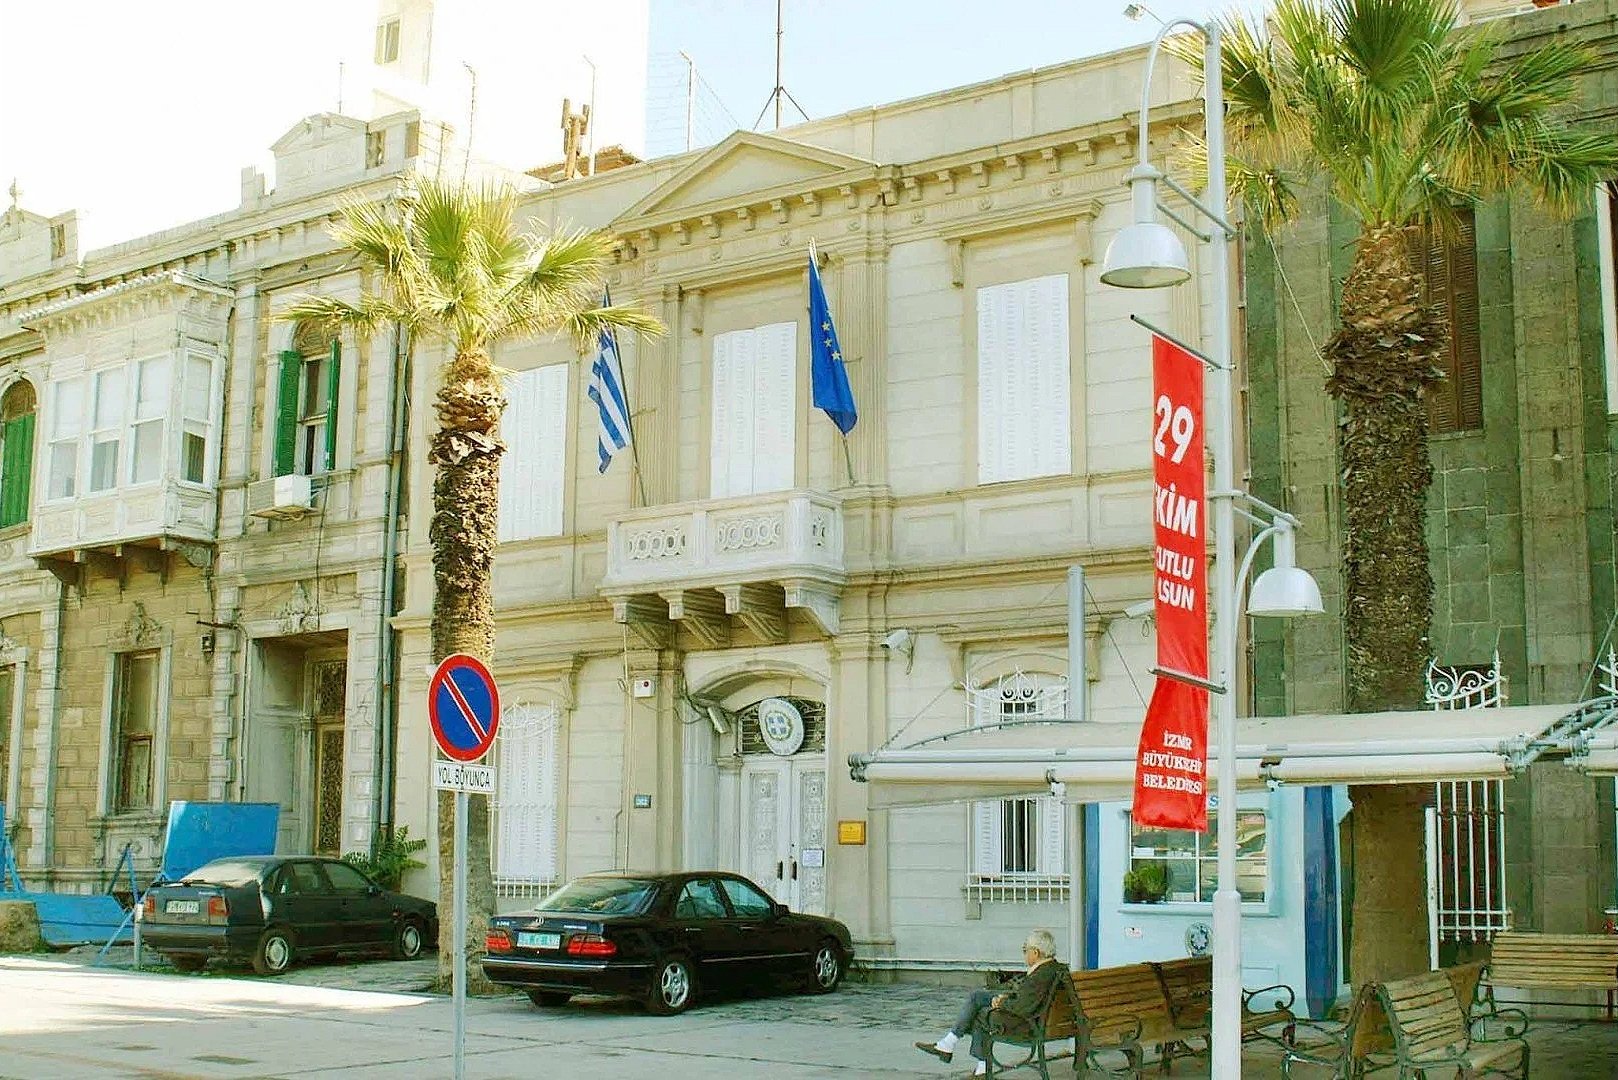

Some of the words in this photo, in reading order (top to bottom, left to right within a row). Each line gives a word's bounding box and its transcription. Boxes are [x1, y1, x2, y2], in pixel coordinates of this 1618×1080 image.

[1154, 394, 1194, 464] 29
[1154, 482, 1198, 538] KİM
[1157, 545, 1195, 580] UTLU
[1157, 576, 1195, 612] LSUN
[438, 766, 452, 784] YOL
[454, 768, 491, 788] BOYUNCA
